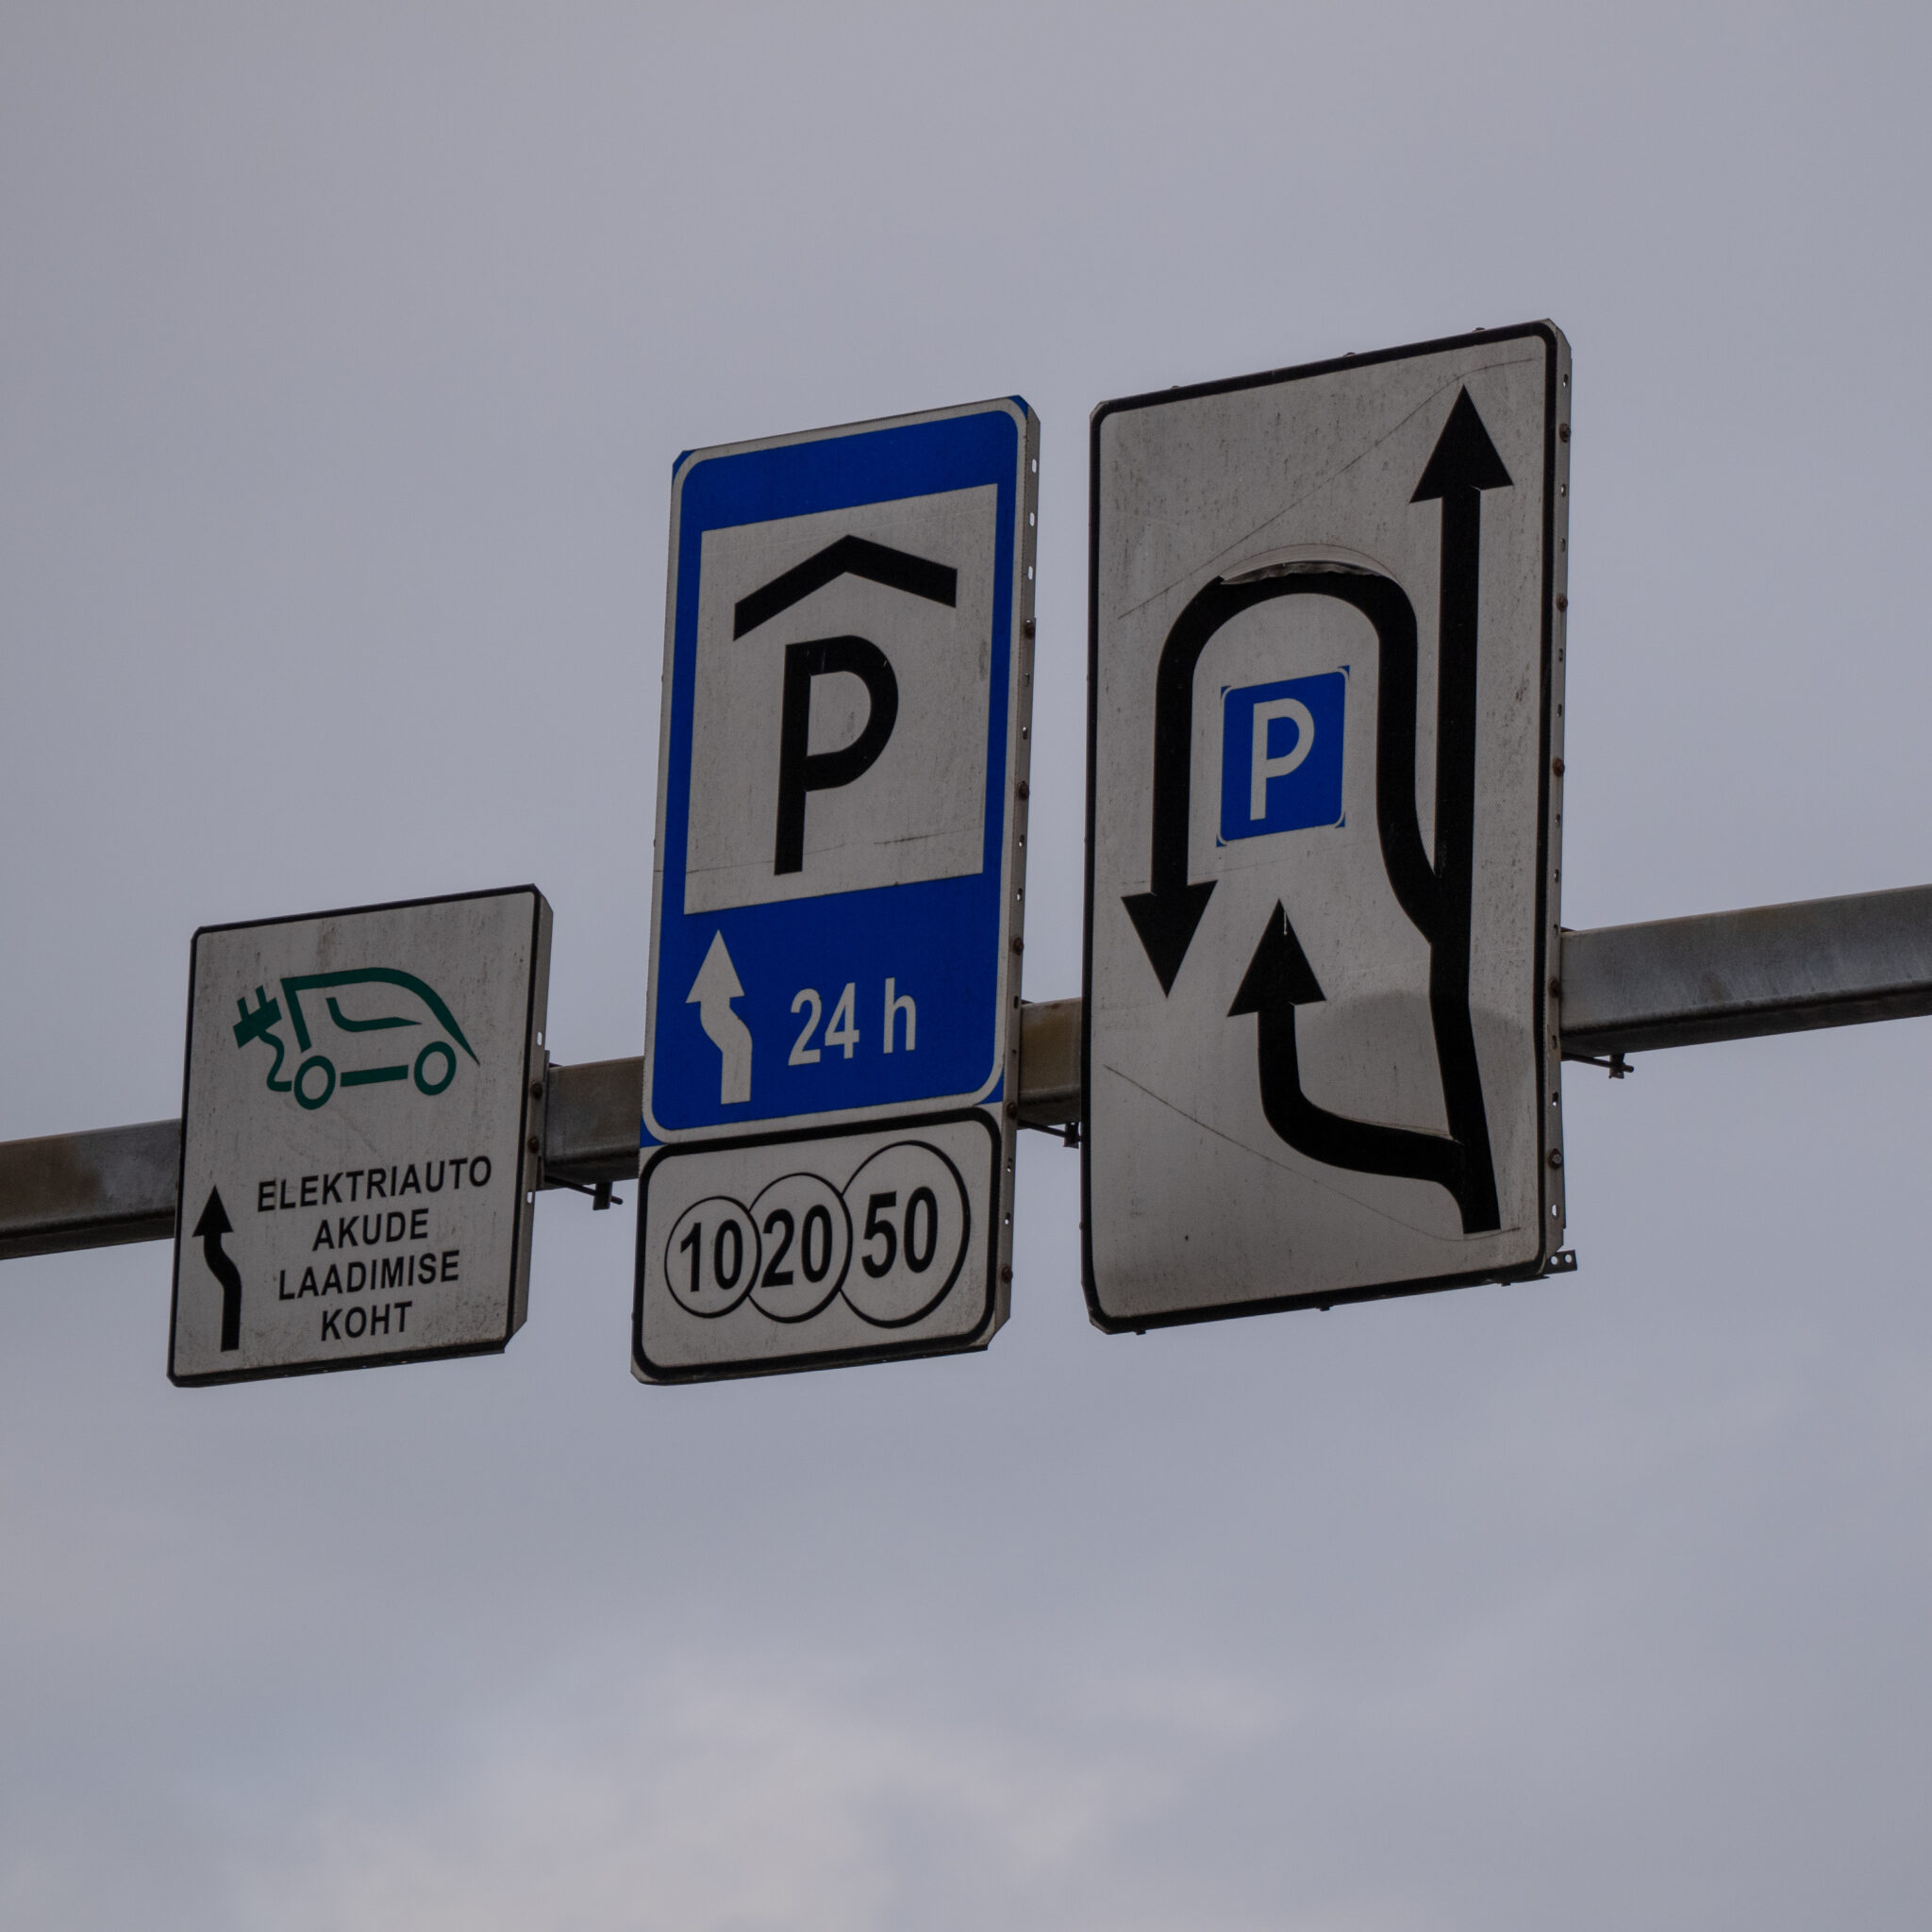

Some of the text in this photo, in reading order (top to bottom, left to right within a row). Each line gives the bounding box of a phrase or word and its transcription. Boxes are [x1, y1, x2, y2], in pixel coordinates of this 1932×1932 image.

[774, 634, 899, 876] P
[1250, 697, 1316, 822] P
[788, 977, 917, 1066] 24 h
[258, 1156, 491, 1212] ELEKTRIAUTO
[312, 1208, 429, 1251] AKUDE
[679, 1186, 939, 1292] 10 20 50
[278, 1249, 460, 1300] LAADIMISE
[321, 1301, 412, 1341] KOHT
